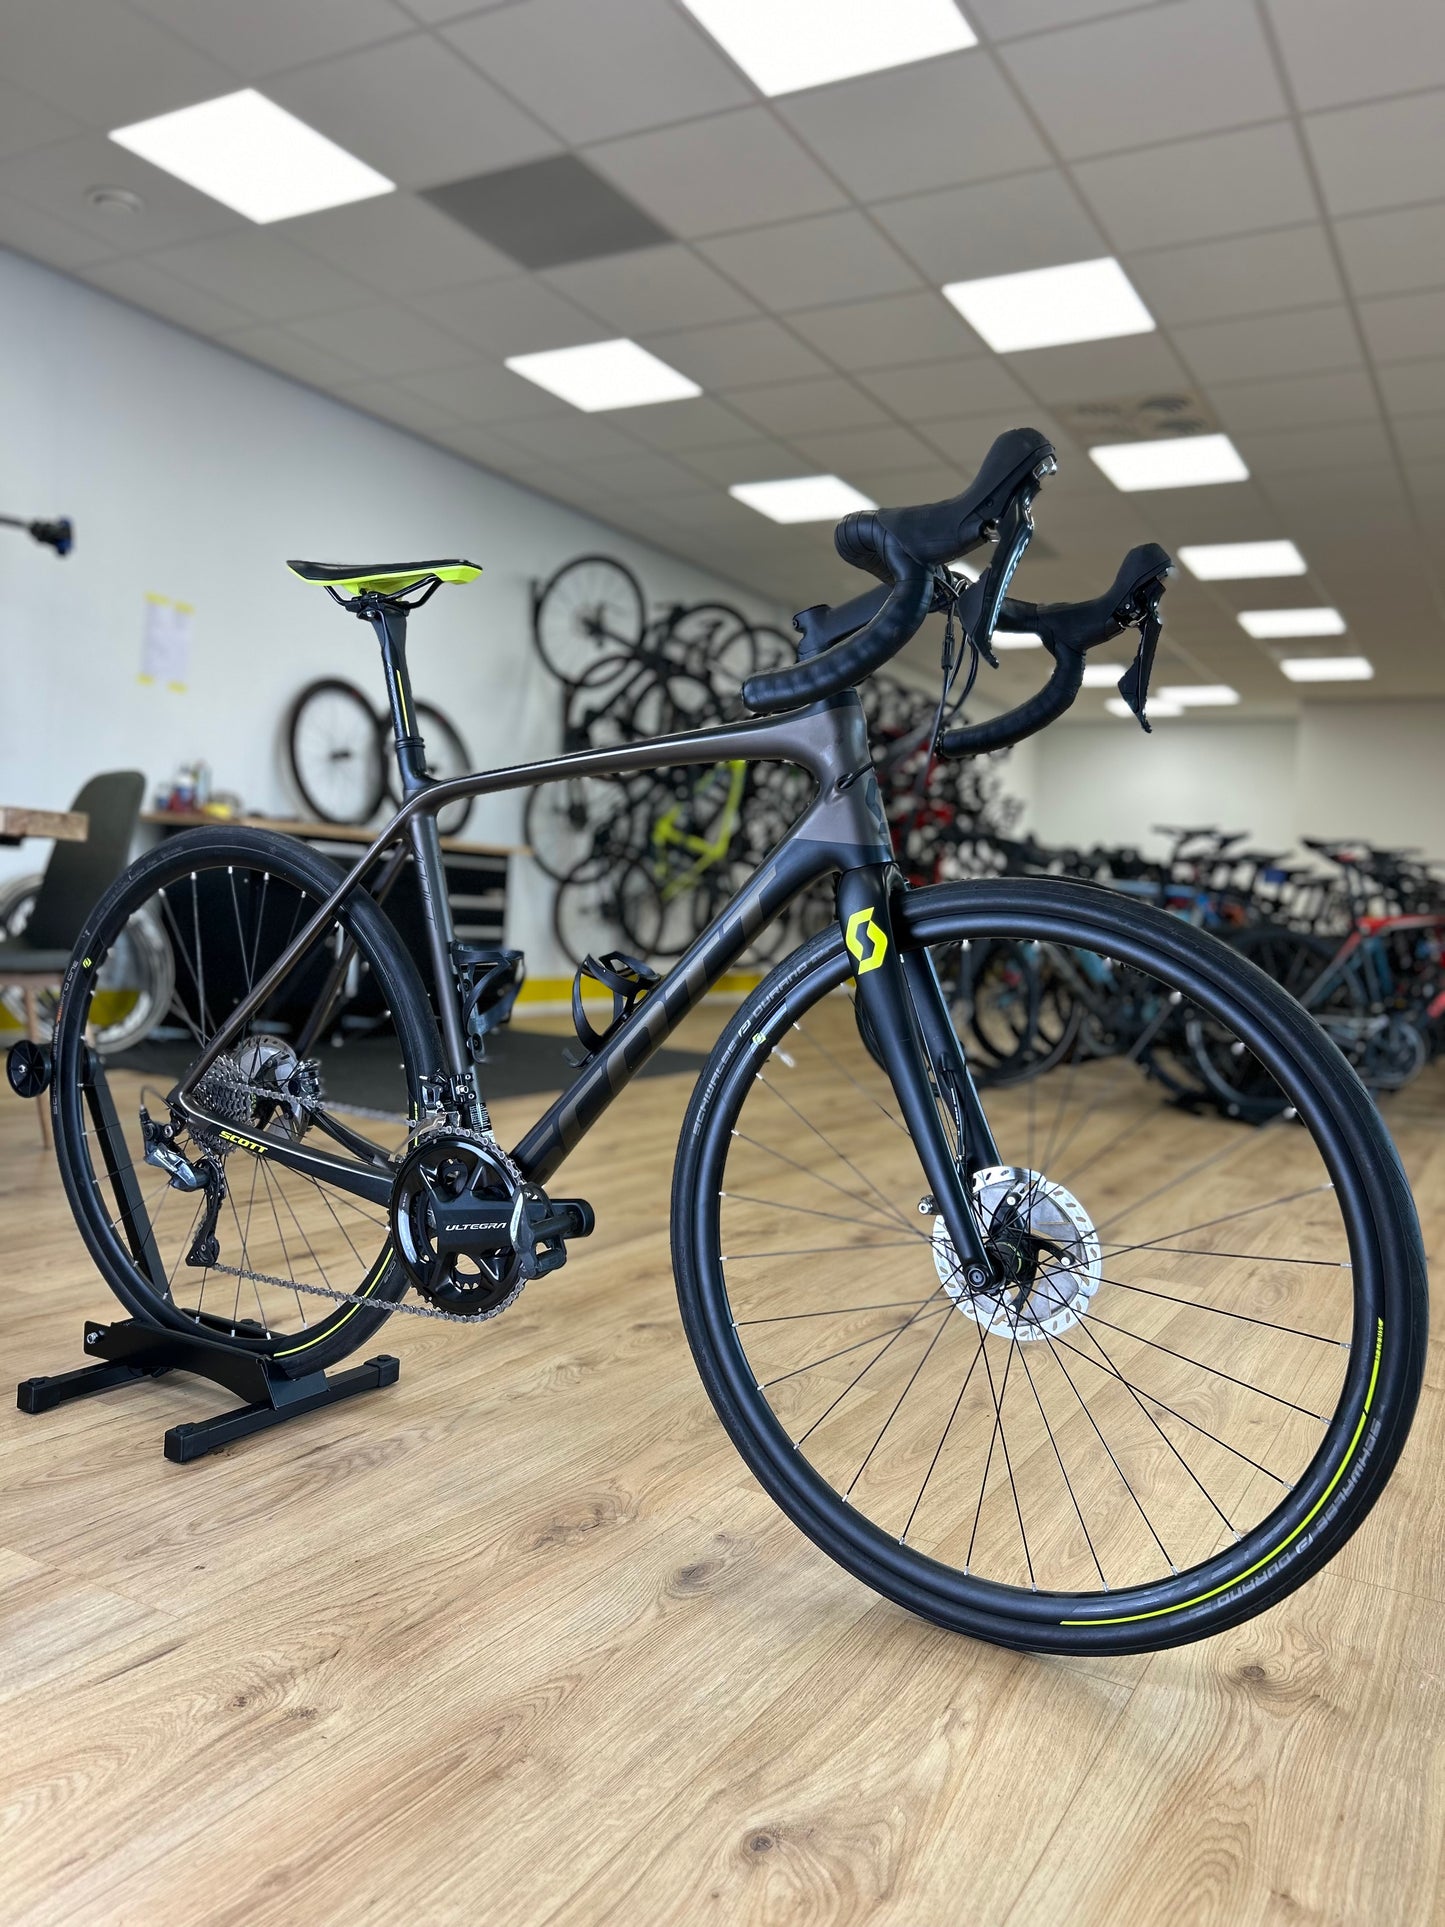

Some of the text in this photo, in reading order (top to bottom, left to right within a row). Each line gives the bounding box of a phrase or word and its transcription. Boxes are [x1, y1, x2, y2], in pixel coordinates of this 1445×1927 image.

[693, 1041, 738, 1137] SCHWALBE
[752, 963, 808, 1019] DURANO
[219, 1130, 268, 1153] SCOTT
[445, 1222, 508, 1232] ULTEGRA
[1315, 1417, 1382, 1533] SCHWALBE
[1216, 1552, 1292, 1608] DURANO
